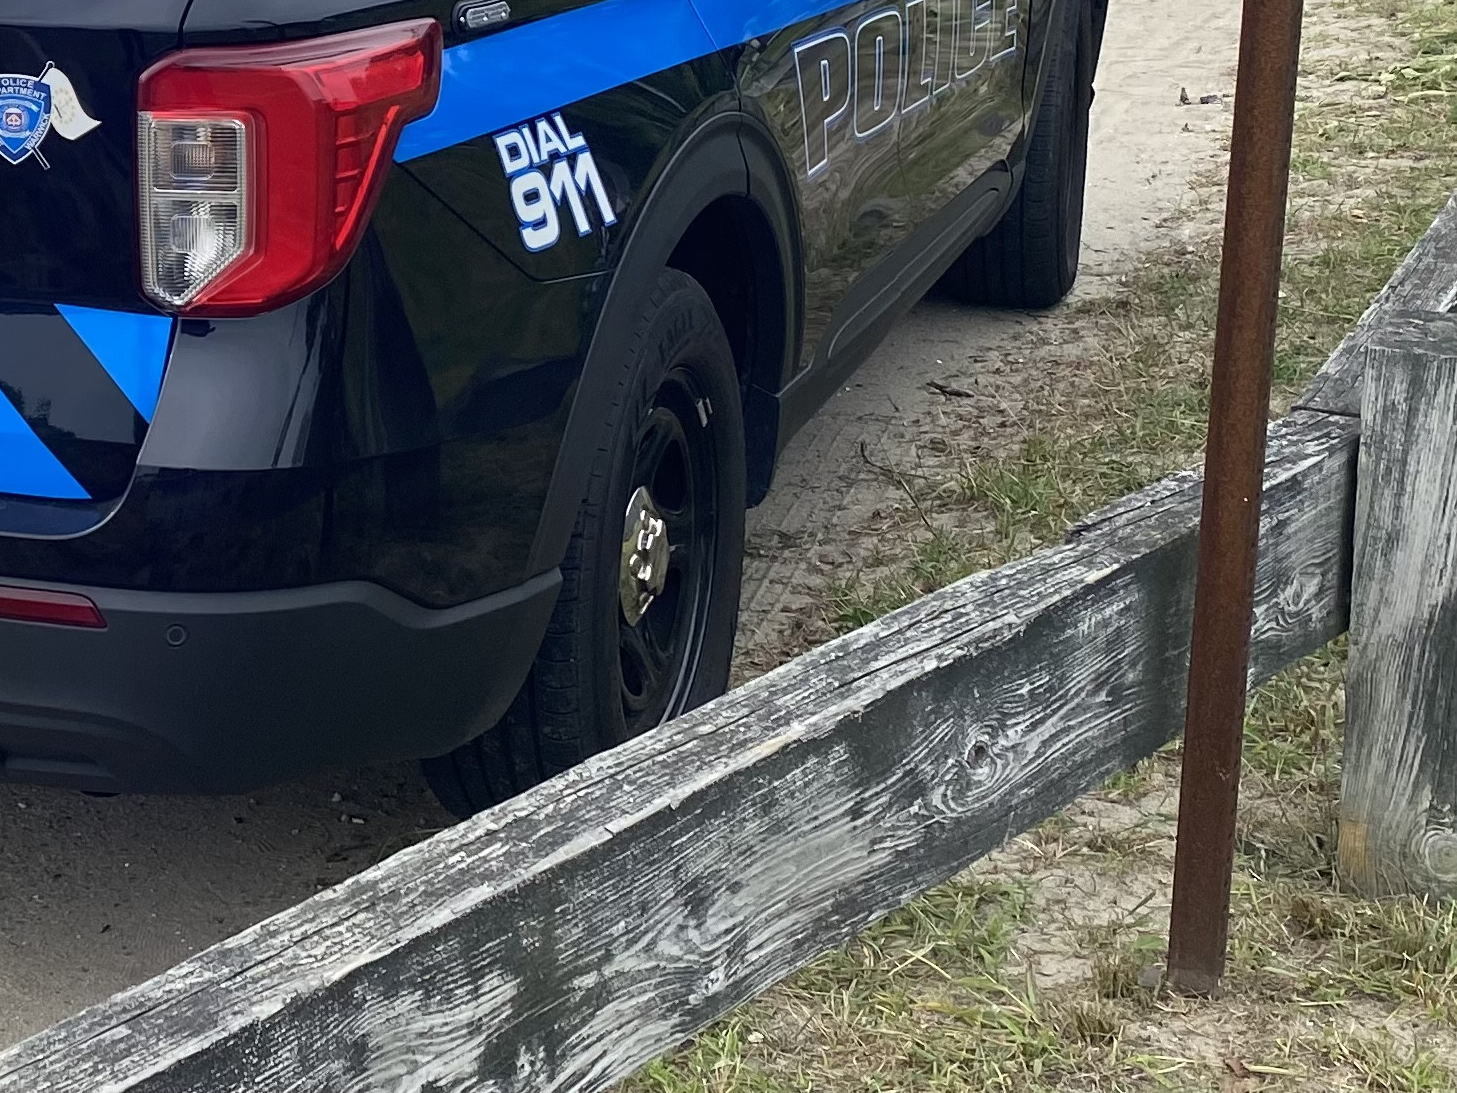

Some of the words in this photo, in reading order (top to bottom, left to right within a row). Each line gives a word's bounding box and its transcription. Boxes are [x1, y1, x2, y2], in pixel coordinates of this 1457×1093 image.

[24, 112, 51, 150] WARWICK
[493, 111, 589, 177] DIAL
[510, 148, 619, 253] 911
